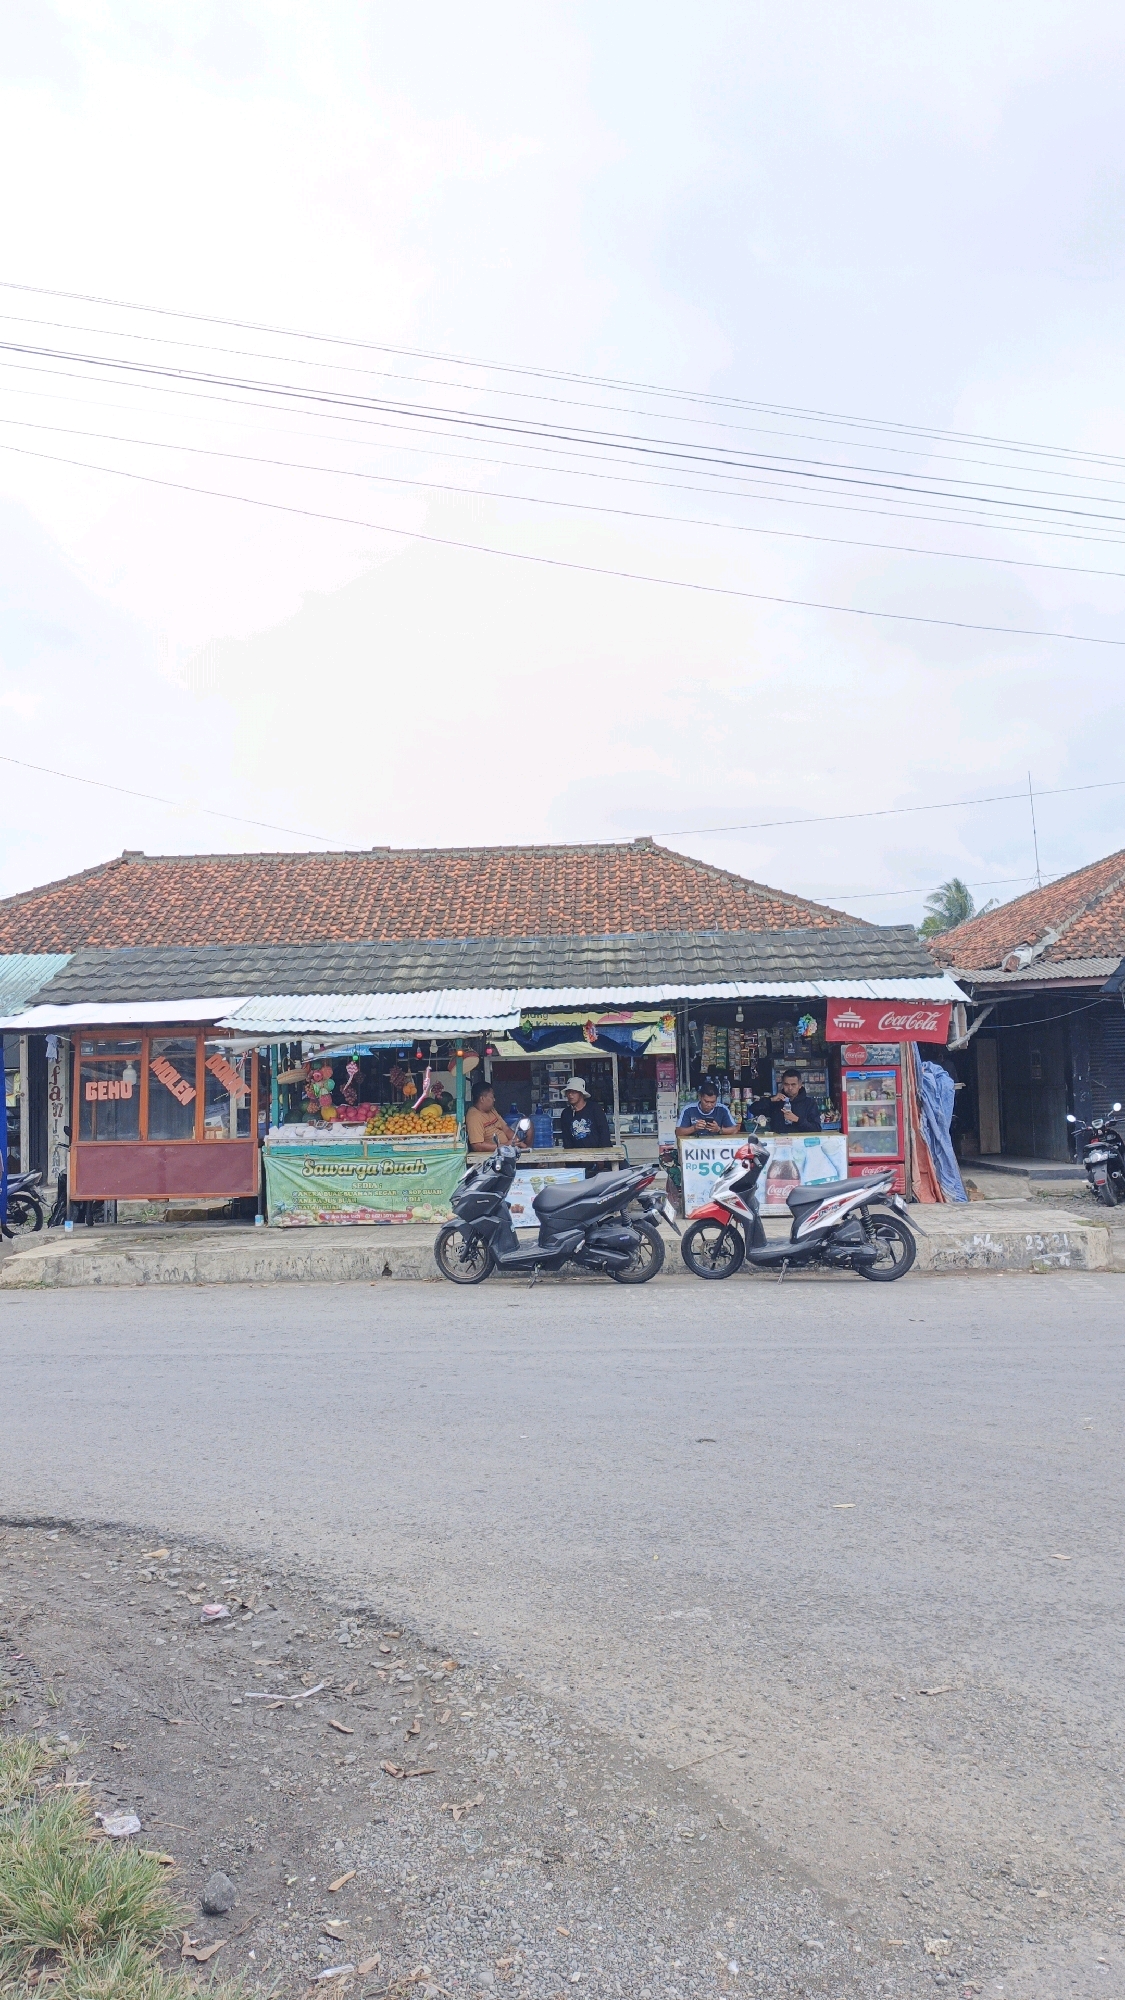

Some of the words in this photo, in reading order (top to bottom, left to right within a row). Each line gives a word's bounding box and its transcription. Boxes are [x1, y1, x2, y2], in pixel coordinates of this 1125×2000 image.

[878, 1010, 944, 1032] Coca-Cola
[149, 1056, 197, 1106] MOLEN
[685, 1149, 715, 1161] KINI
[303, 1158, 378, 1180] Sawarga
[380, 1158, 427, 1176] Buah
